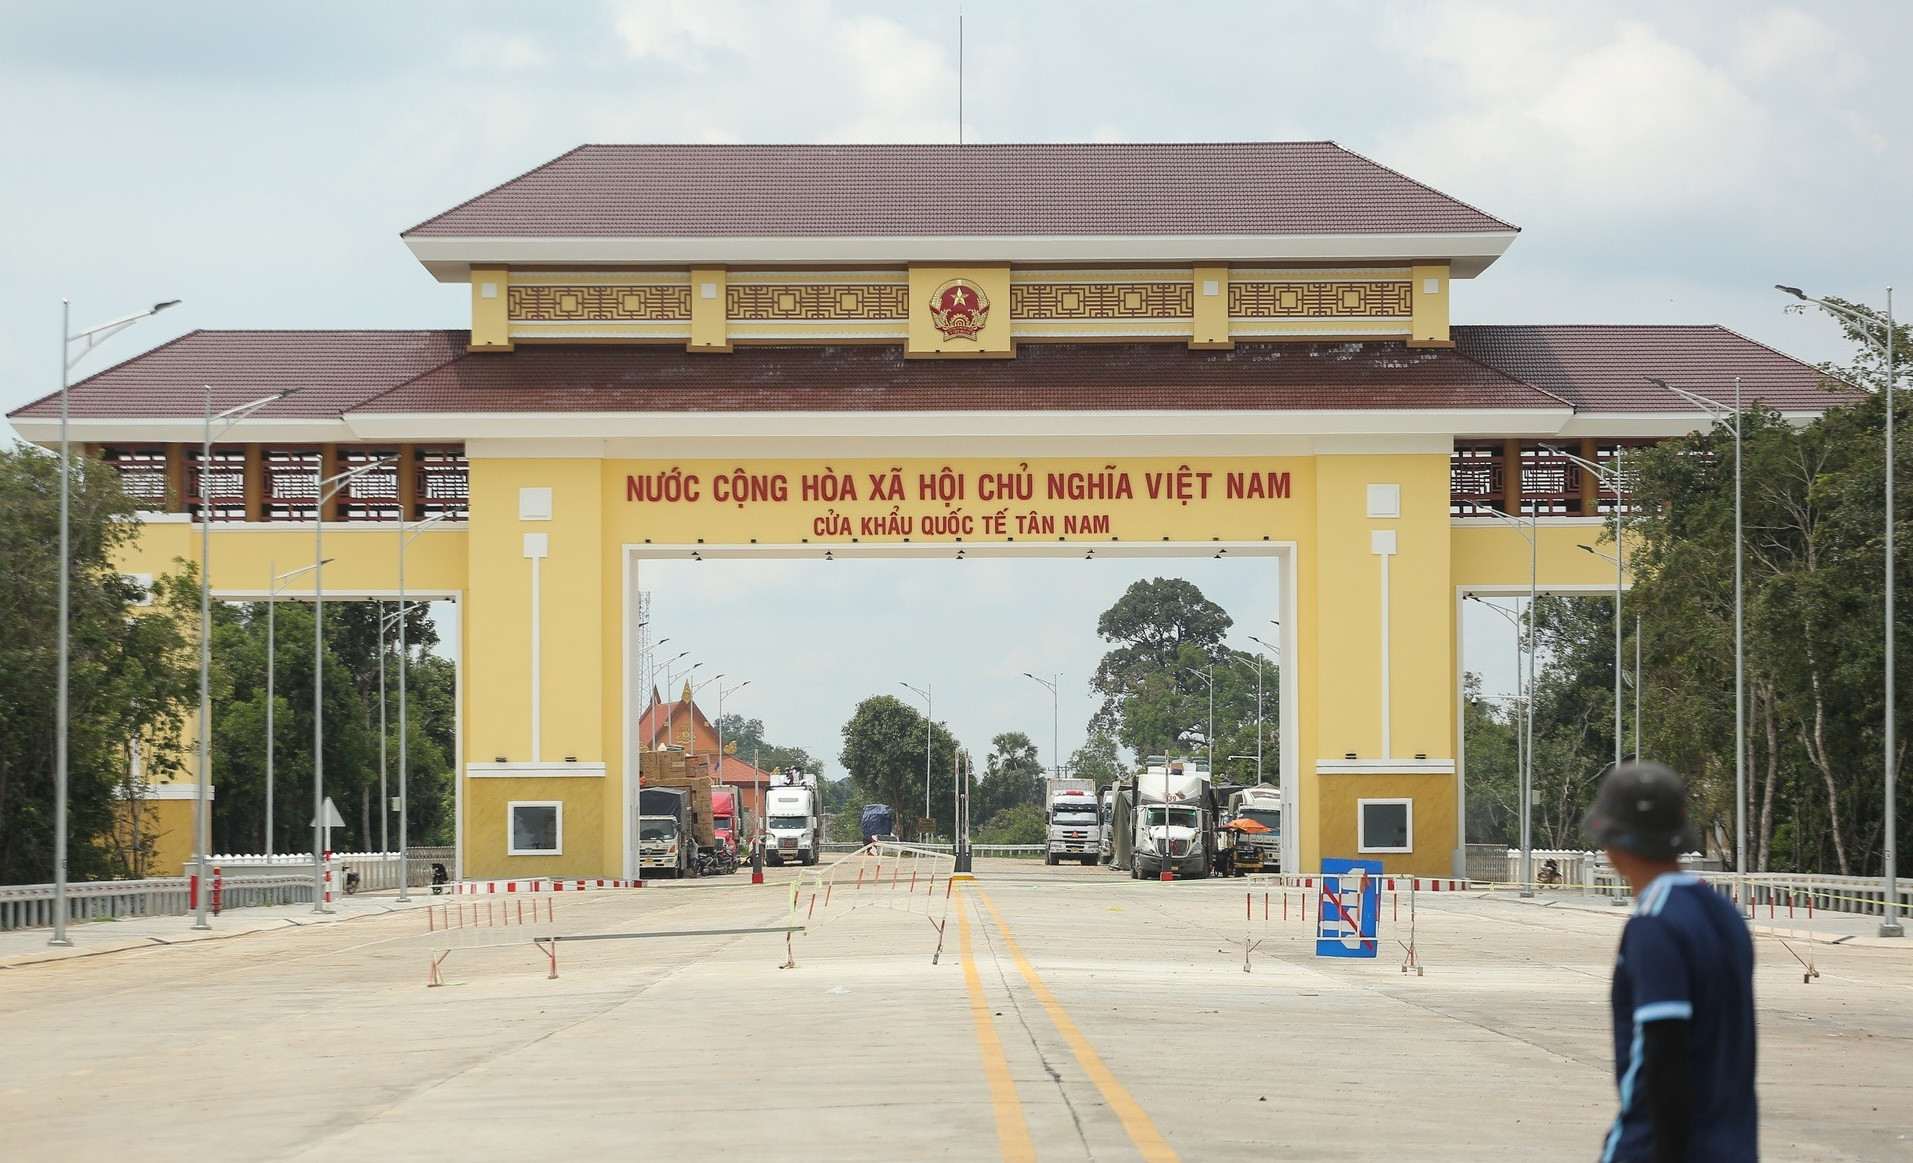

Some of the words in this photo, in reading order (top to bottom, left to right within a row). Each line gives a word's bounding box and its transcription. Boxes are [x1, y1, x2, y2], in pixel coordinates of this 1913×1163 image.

[626, 467, 700, 504] NƯỚC
[712, 468, 789, 508] CỘNG
[801, 467, 858, 502] HÒA
[869, 467, 906, 501] XÃ
[919, 466, 965, 506] HỘI
[978, 464, 1034, 501] CHỦ
[1047, 464, 1133, 500] NGHĨA
[1145, 466, 1212, 506] VIỆT
[1226, 472, 1292, 499] NAM
[813, 509, 852, 536] CỬA
[861, 505, 914, 535] KHẨU
[921, 508, 973, 536] QUỐC
[983, 507, 1008, 534] TẾ
[1016, 511, 1054, 534] TÂN
[1064, 515, 1110, 534] NAM
